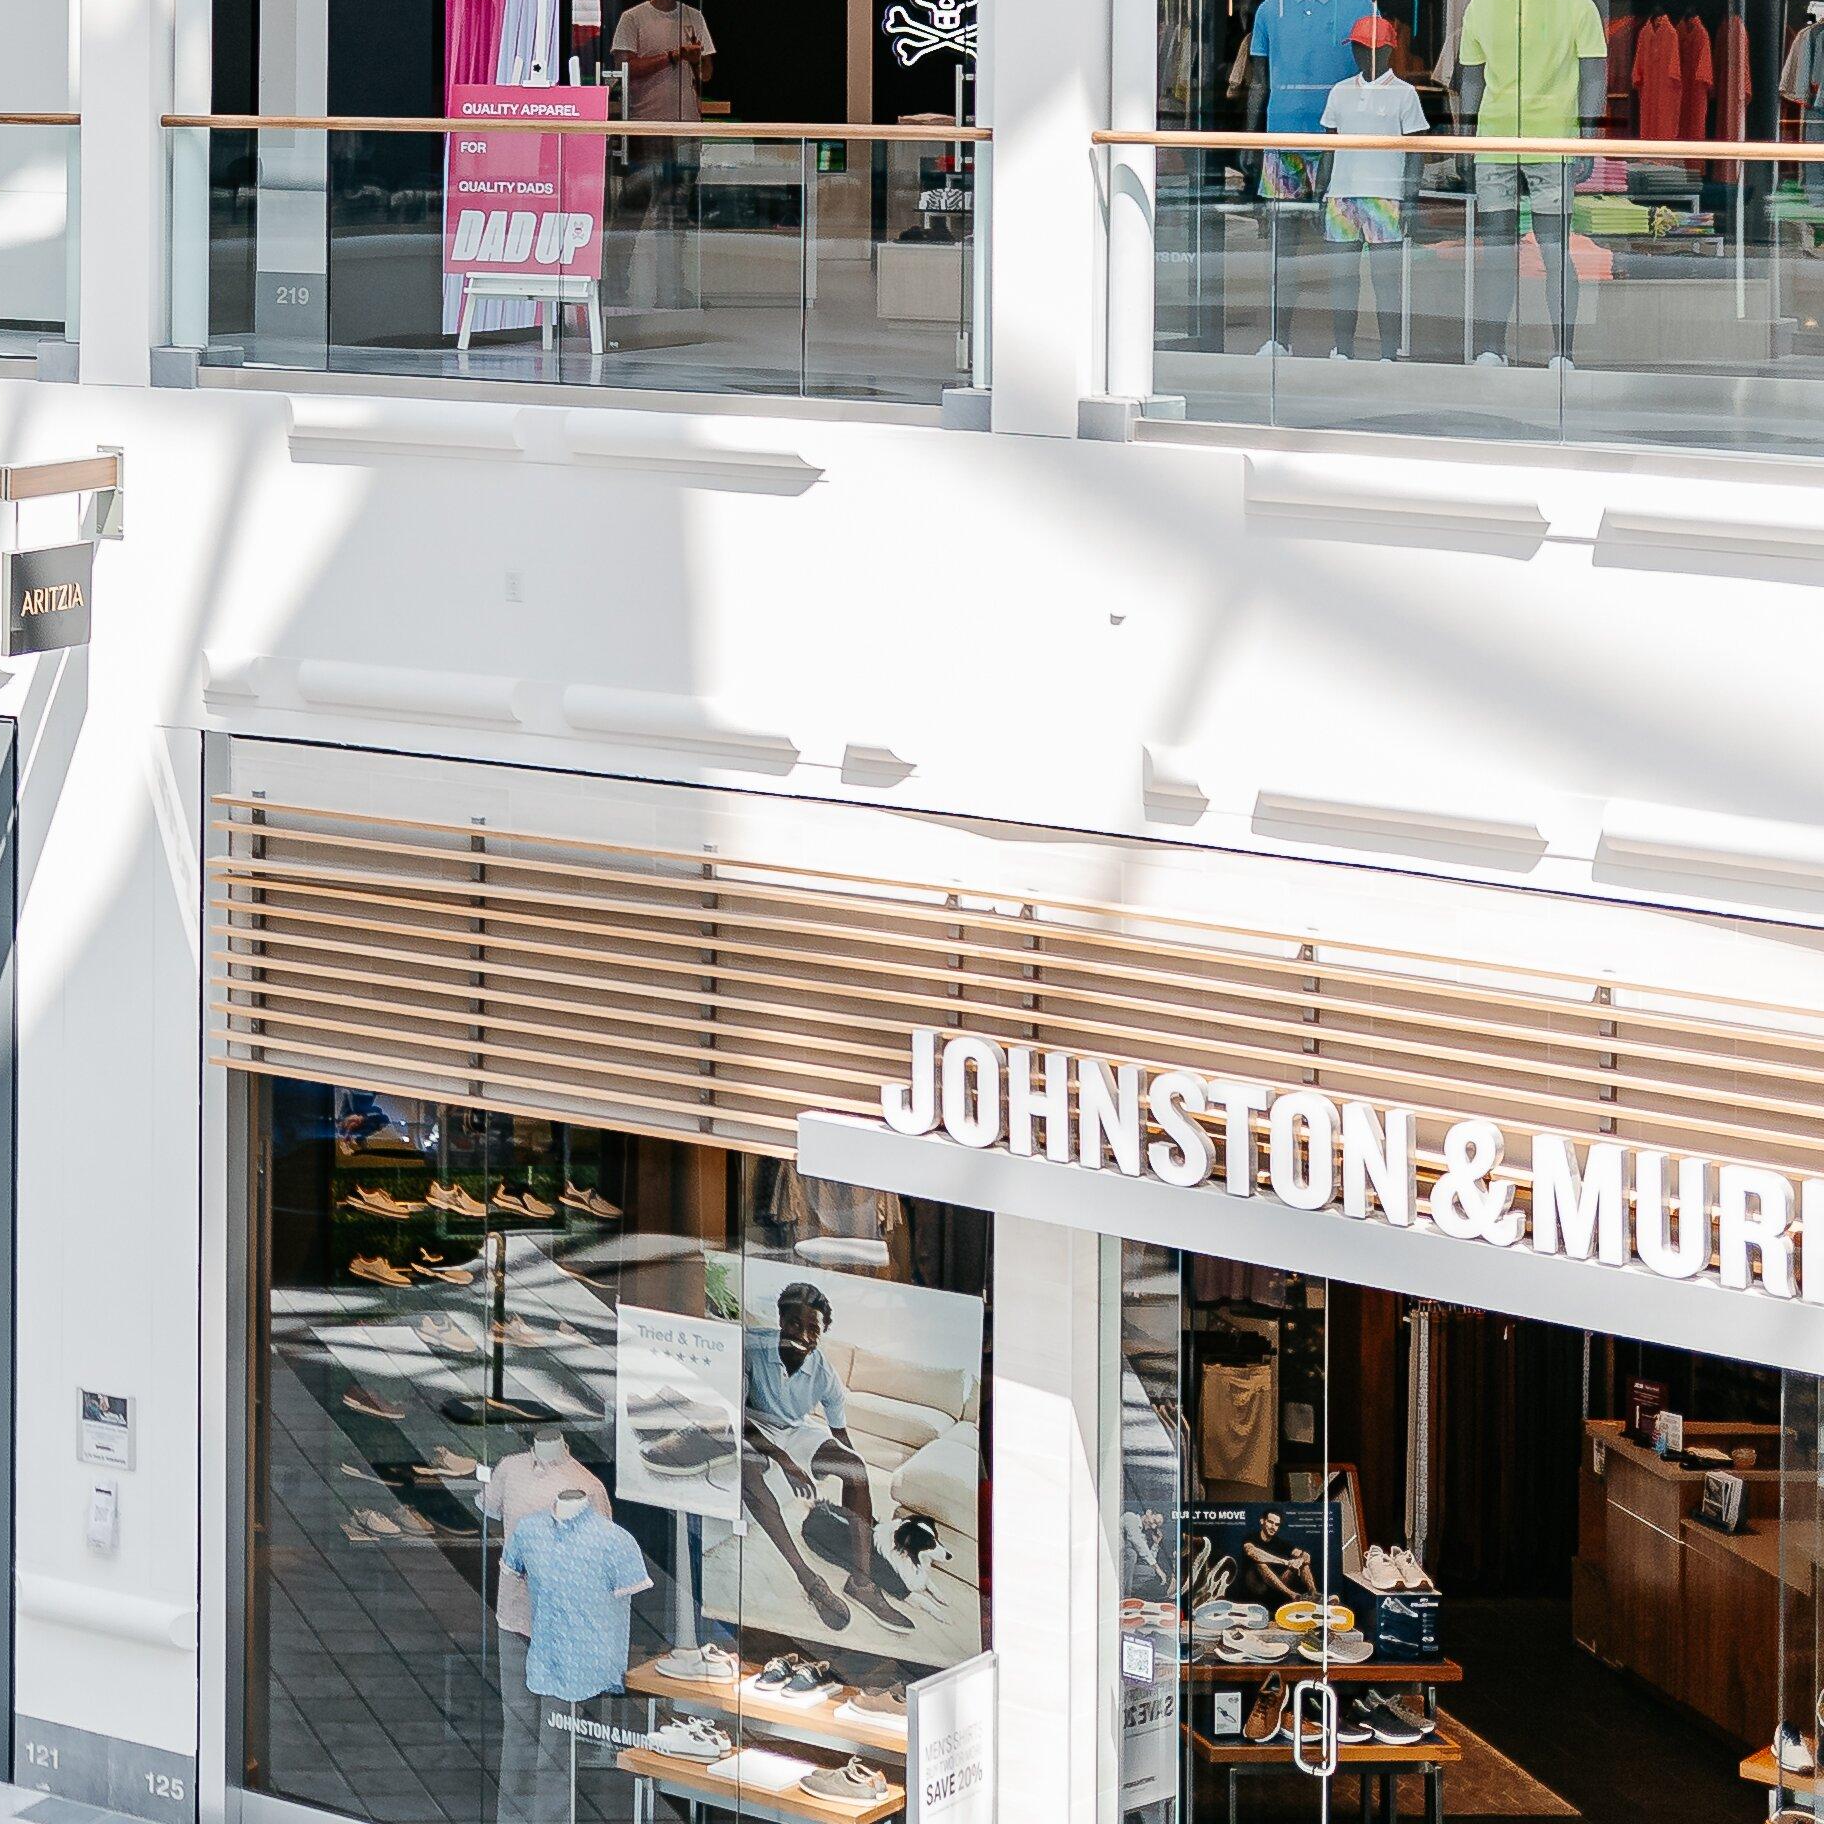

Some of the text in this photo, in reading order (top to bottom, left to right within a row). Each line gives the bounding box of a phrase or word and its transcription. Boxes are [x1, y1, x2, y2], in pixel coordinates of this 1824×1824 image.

[462, 103, 580, 117] QUALITY APPAREL
[460, 142, 487, 154] FOR
[458, 181, 554, 194] QUALITY DADS
[451, 210, 594, 265] DAD UP
[276, 286, 309, 305] 219
[20, 582, 84, 617] ARITZIA
[637, 1324, 725, 1352] Tried & True
[1202, 1511, 1217, 1520] TO
[1218, 1510, 1246, 1520] MOVE
[25, 1741, 59, 1770] 121
[145, 1771, 185, 1800] 125
[926, 1761, 984, 1807] SAVE 20%
